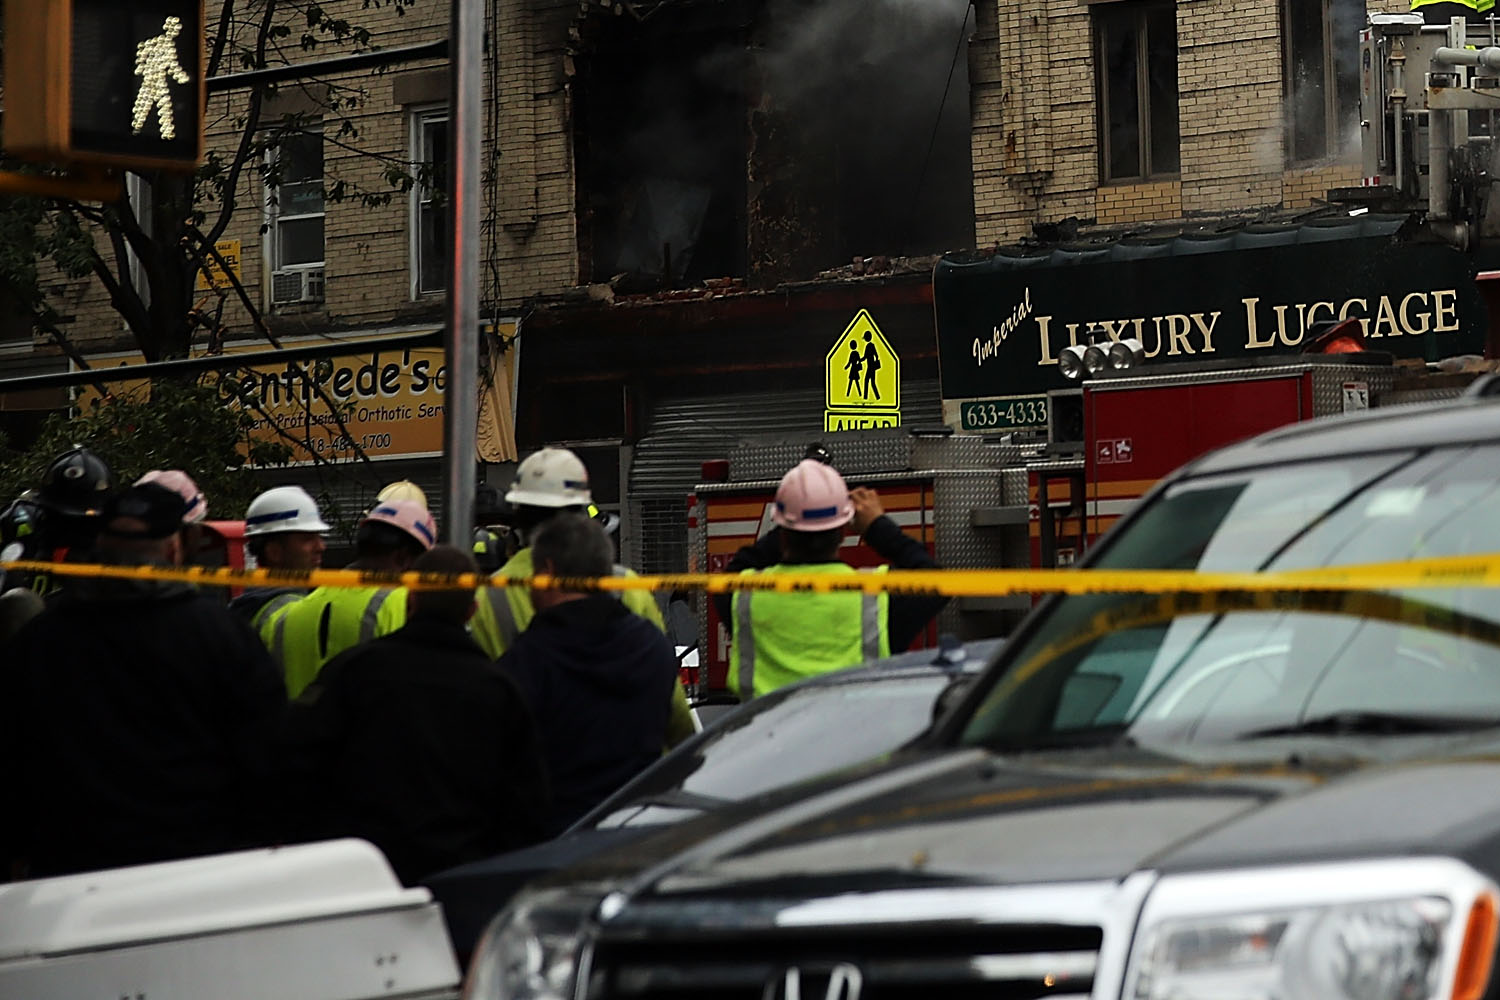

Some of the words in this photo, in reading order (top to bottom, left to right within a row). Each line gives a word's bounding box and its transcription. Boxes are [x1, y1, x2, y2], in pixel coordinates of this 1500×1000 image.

[972, 287, 1033, 366] Imperial
[1034, 311, 1222, 365] LUXURY
[1242, 289, 1460, 350] LUGGAGE
[358, 404, 412, 423] Orthotic
[418, 402, 449, 418] Serv
[966, 400, 1048, 428] 633-4333
